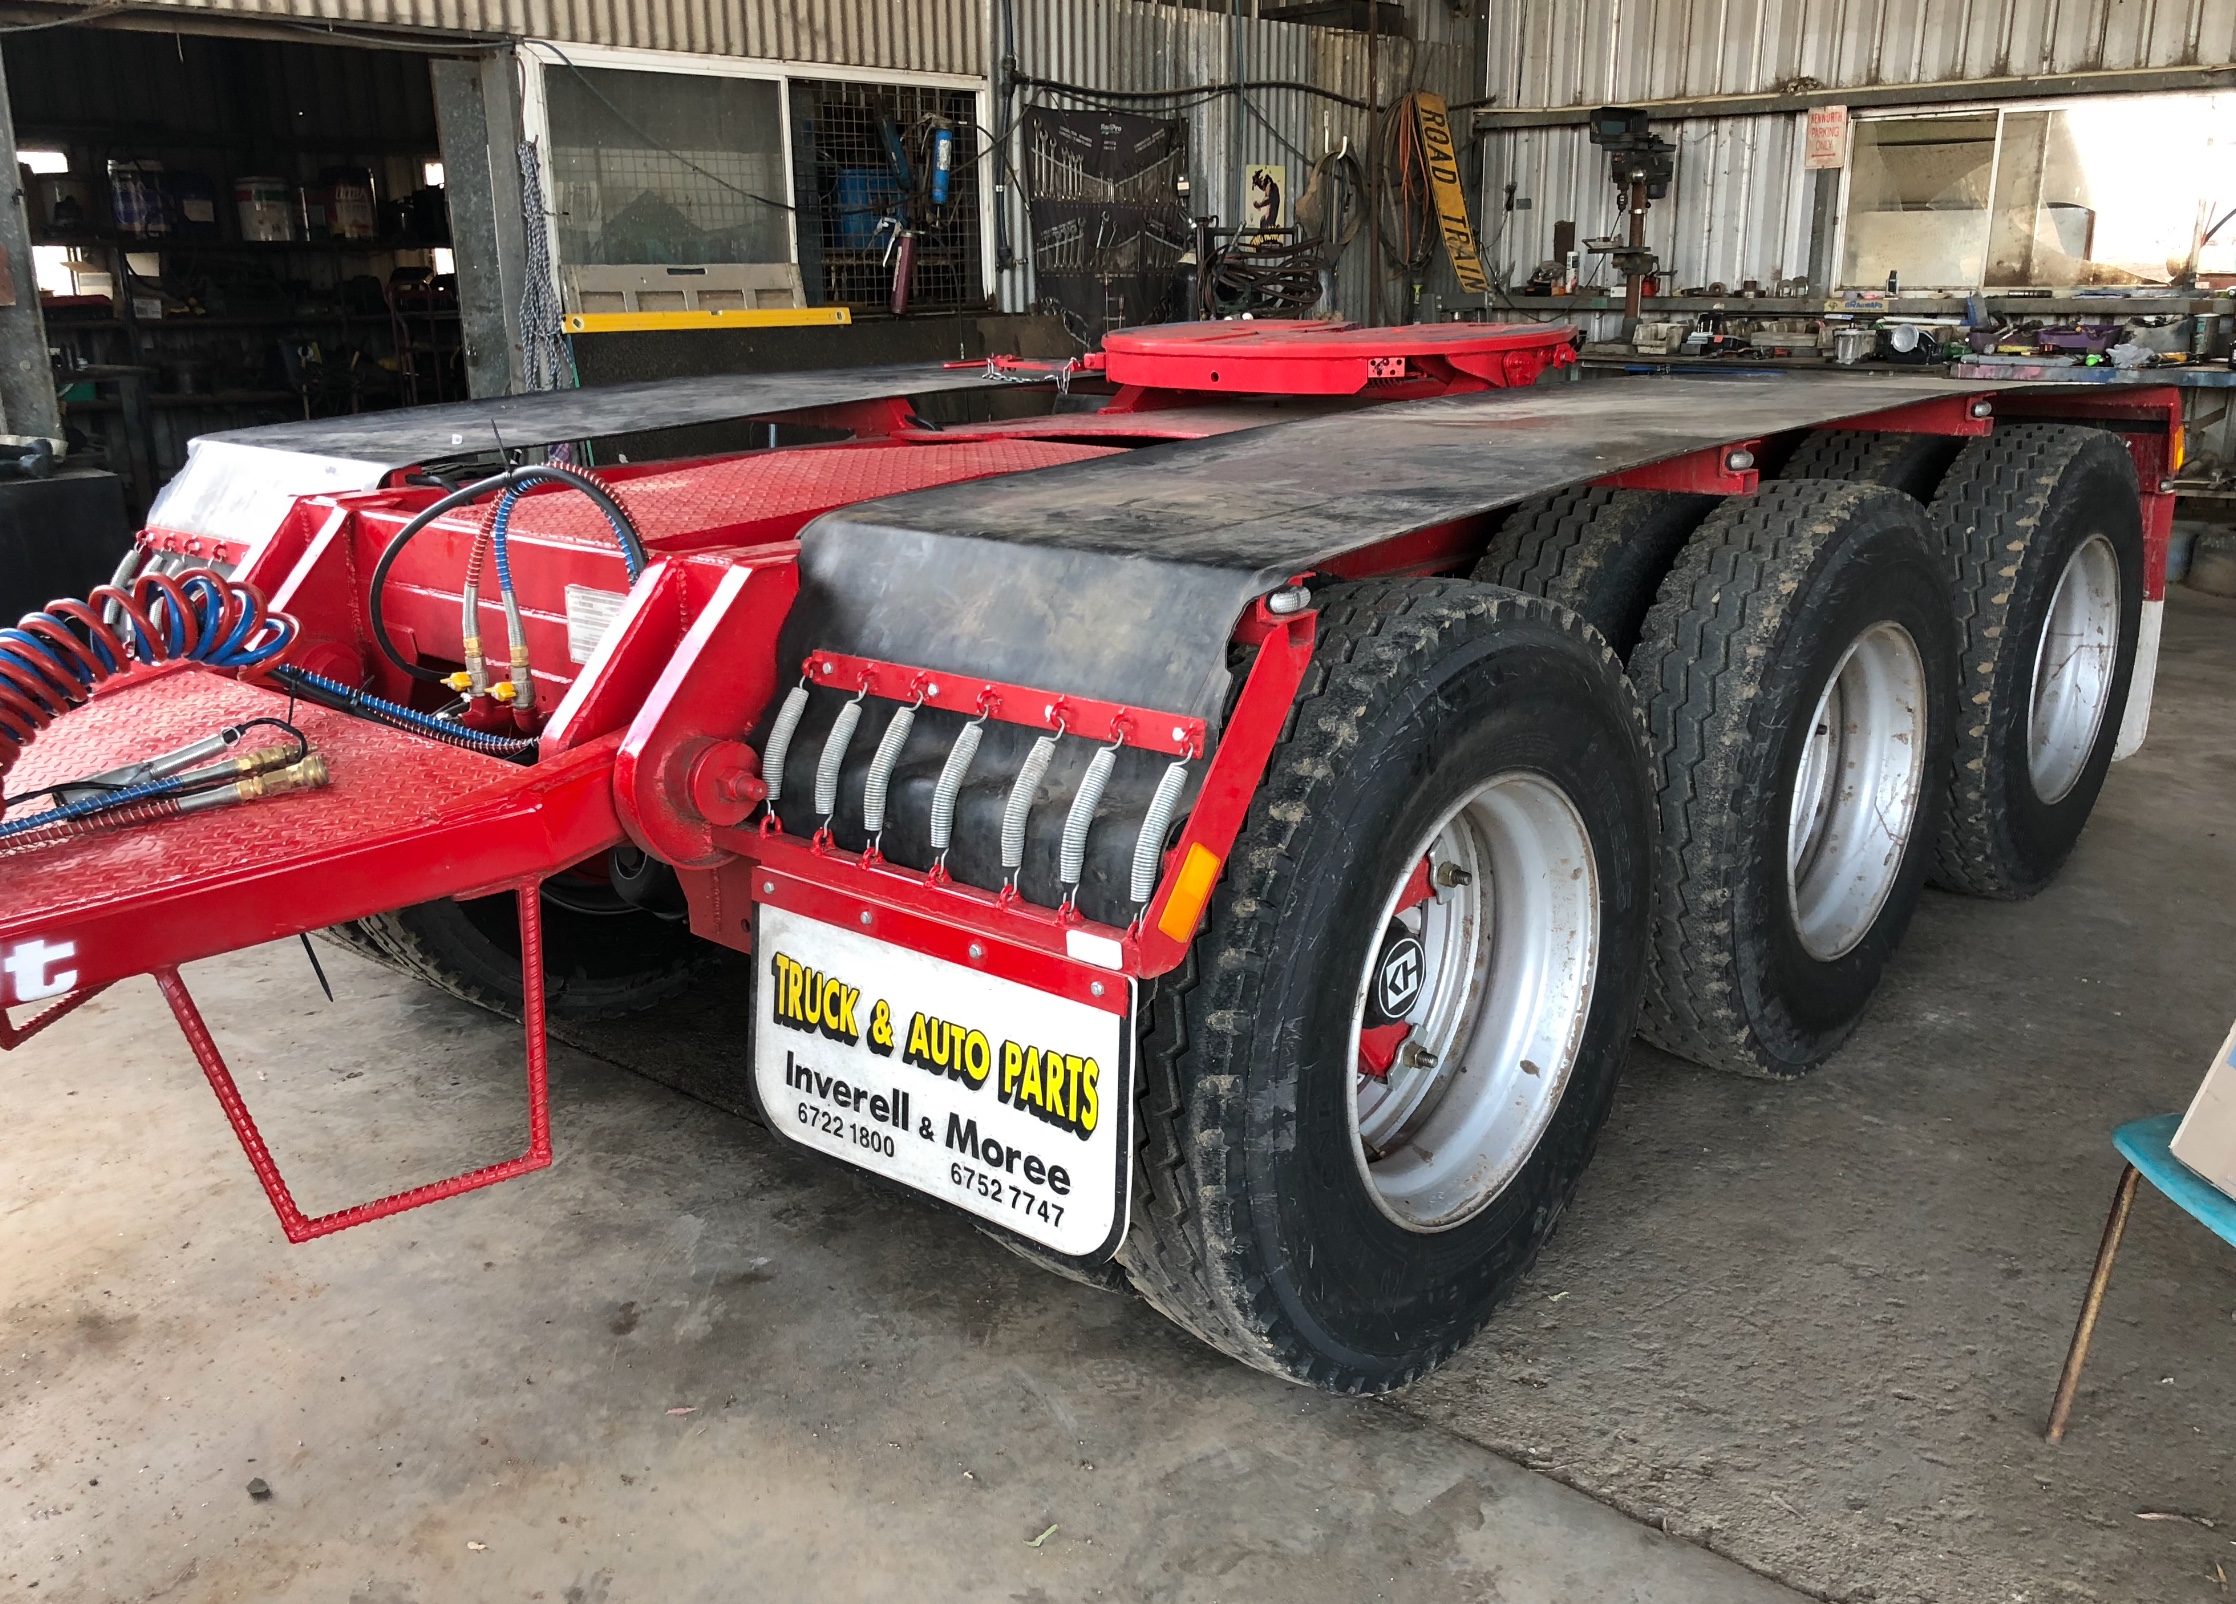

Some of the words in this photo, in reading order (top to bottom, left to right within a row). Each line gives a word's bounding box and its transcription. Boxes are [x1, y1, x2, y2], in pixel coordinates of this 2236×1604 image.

[1811, 112, 1842, 123] KENWORTH
[1811, 127, 1840, 138] PARKING
[1816, 140, 1833, 151] ONLY
[1421, 107, 1457, 185] ROAD
[1442, 214, 1488, 292] TRAIN
[772, 951, 860, 1045] TRUCK
[867, 998, 894, 1056] &
[902, 1012, 991, 1090] AUTO
[998, 1039, 1100, 1141] PARTS
[786, 1050, 910, 1131] Inverell
[919, 1116, 936, 1142] &
[945, 1112, 1071, 1196] Moree
[797, 1102, 844, 1138] 6722
[850, 1122, 895, 1158] 1800
[950, 1162, 1003, 1204] 6752
[1009, 1185, 1065, 1228] 7747
